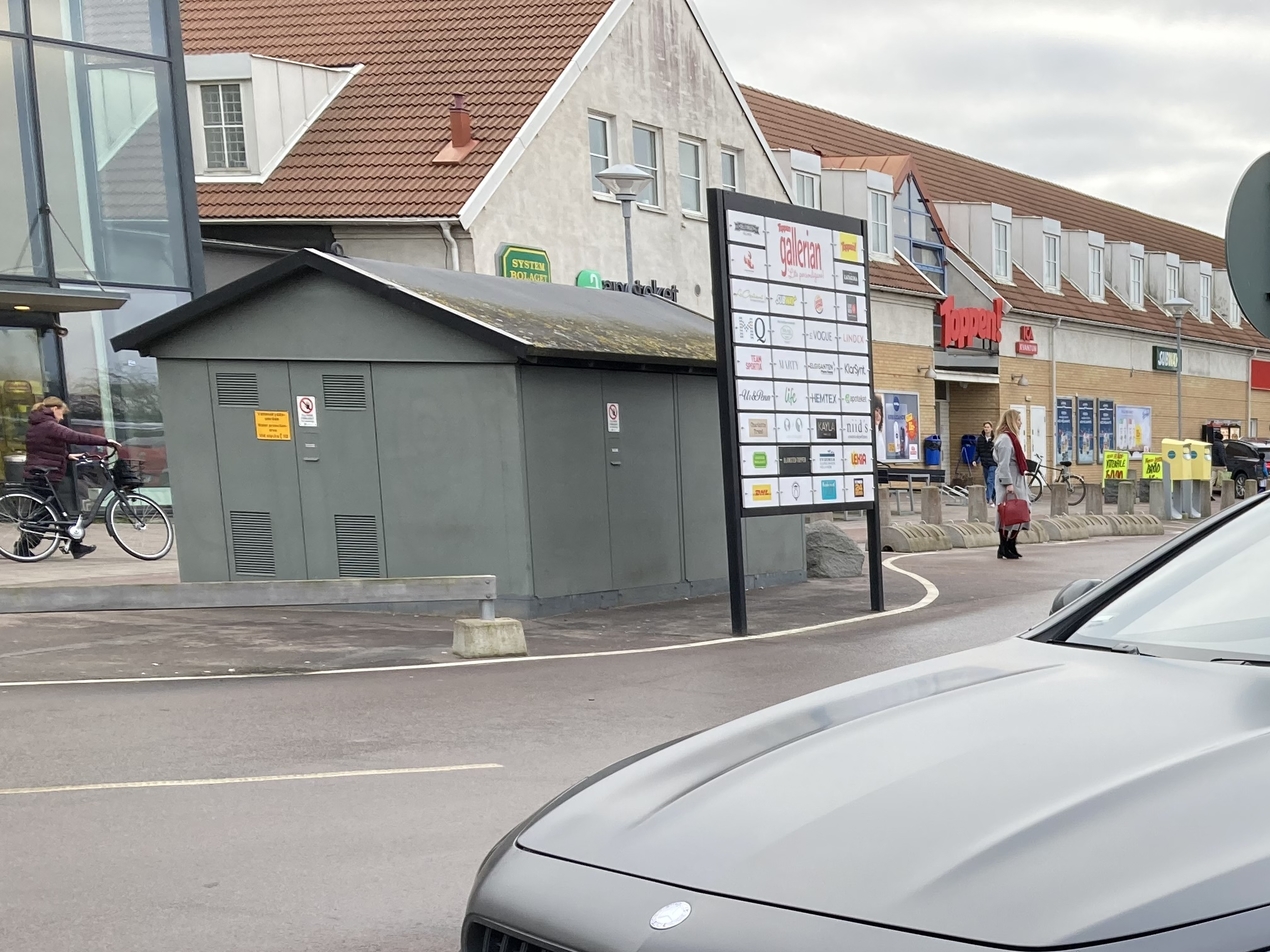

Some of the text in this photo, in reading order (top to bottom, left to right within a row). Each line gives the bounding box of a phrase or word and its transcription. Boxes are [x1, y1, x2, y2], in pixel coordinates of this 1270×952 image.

[780, 226, 822, 277] gallerian
[512, 258, 545, 272] SYSTEM
[510, 270, 548, 283] BOLAGET
[936, 295, 1003, 349] Toppen!
[1021, 326, 1034, 341] ICA
[811, 394, 837, 404] HEMTEX
